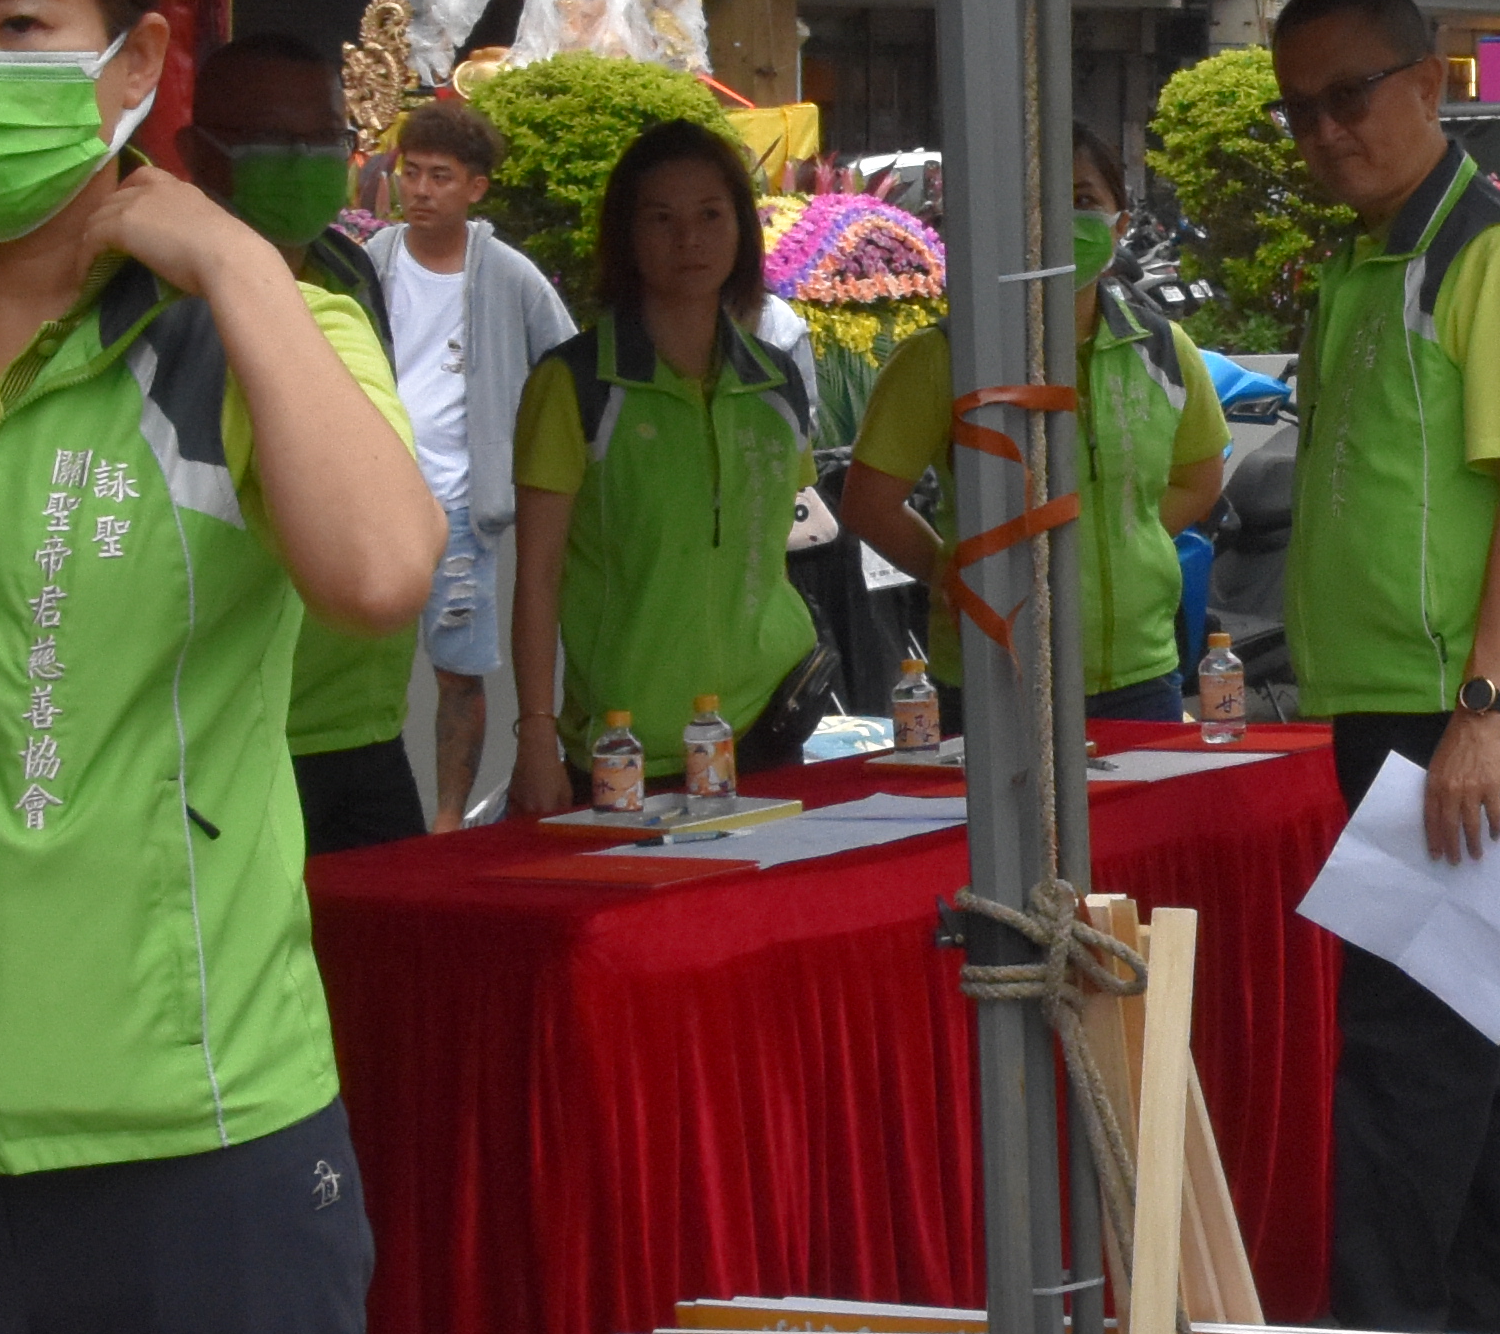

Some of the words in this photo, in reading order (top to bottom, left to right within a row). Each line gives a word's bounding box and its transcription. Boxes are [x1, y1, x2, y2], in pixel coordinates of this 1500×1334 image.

[14, 447, 94, 830] 關聖帝君慈善協會
